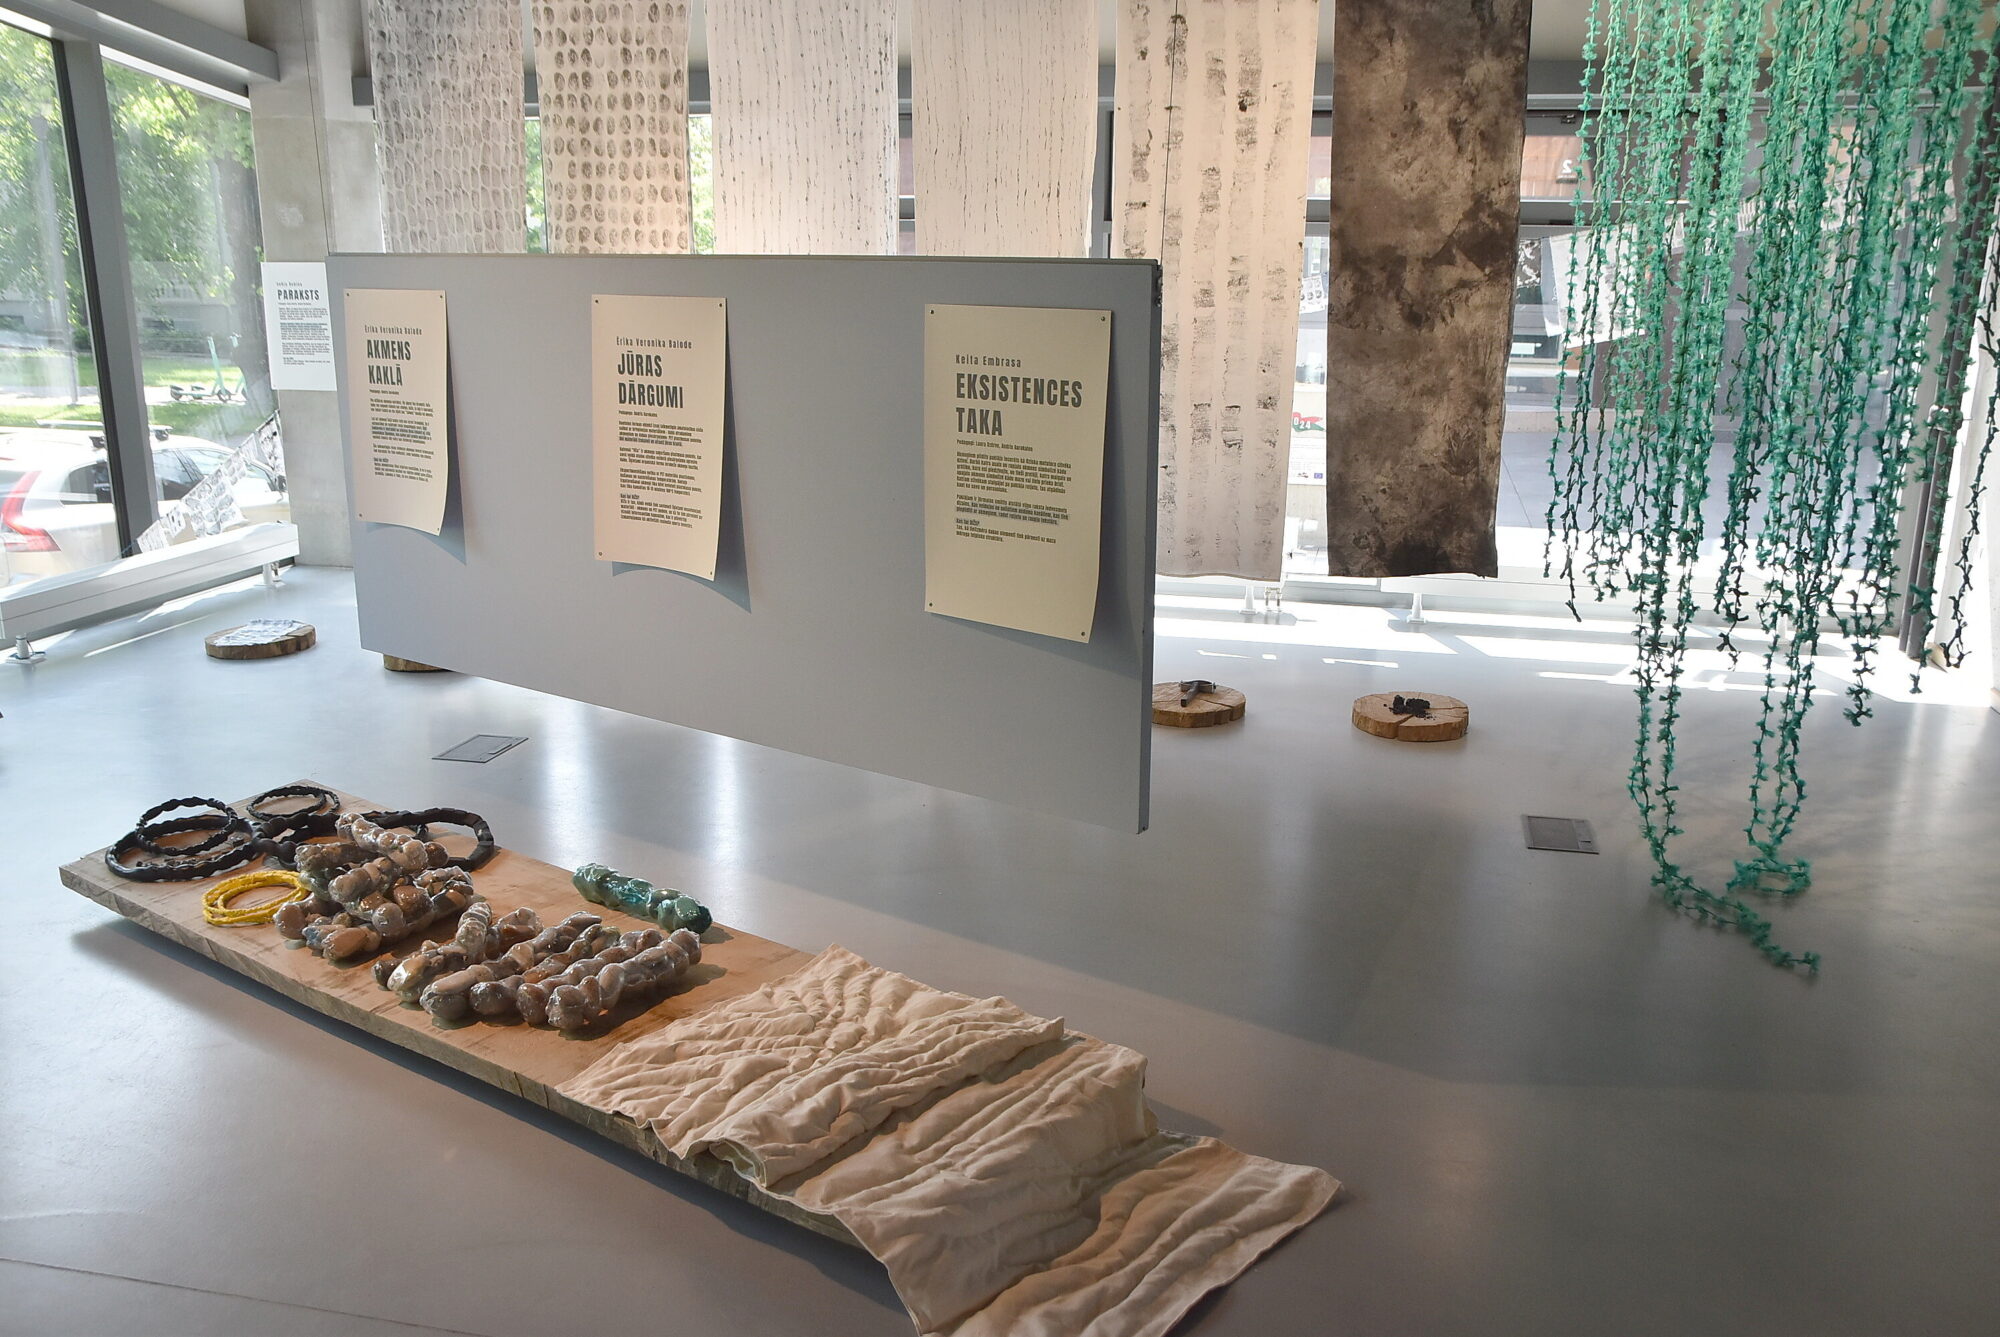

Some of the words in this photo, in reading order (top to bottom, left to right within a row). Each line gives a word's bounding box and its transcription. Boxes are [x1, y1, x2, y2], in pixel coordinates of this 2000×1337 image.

[277, 289, 320, 300] PARAKSTS
[367, 339, 411, 361] AKMENS
[635, 338, 666, 348] Veronika
[668, 339, 692, 349] Balode
[617, 350, 662, 377] JŪRAS
[982, 355, 1021, 368] Embrasa
[368, 363, 403, 386] KAKLĀ
[618, 379, 683, 408] DĀRGUMI
[956, 372, 1082, 408] EKSISTENCES
[955, 407, 1002, 436] TAKA
